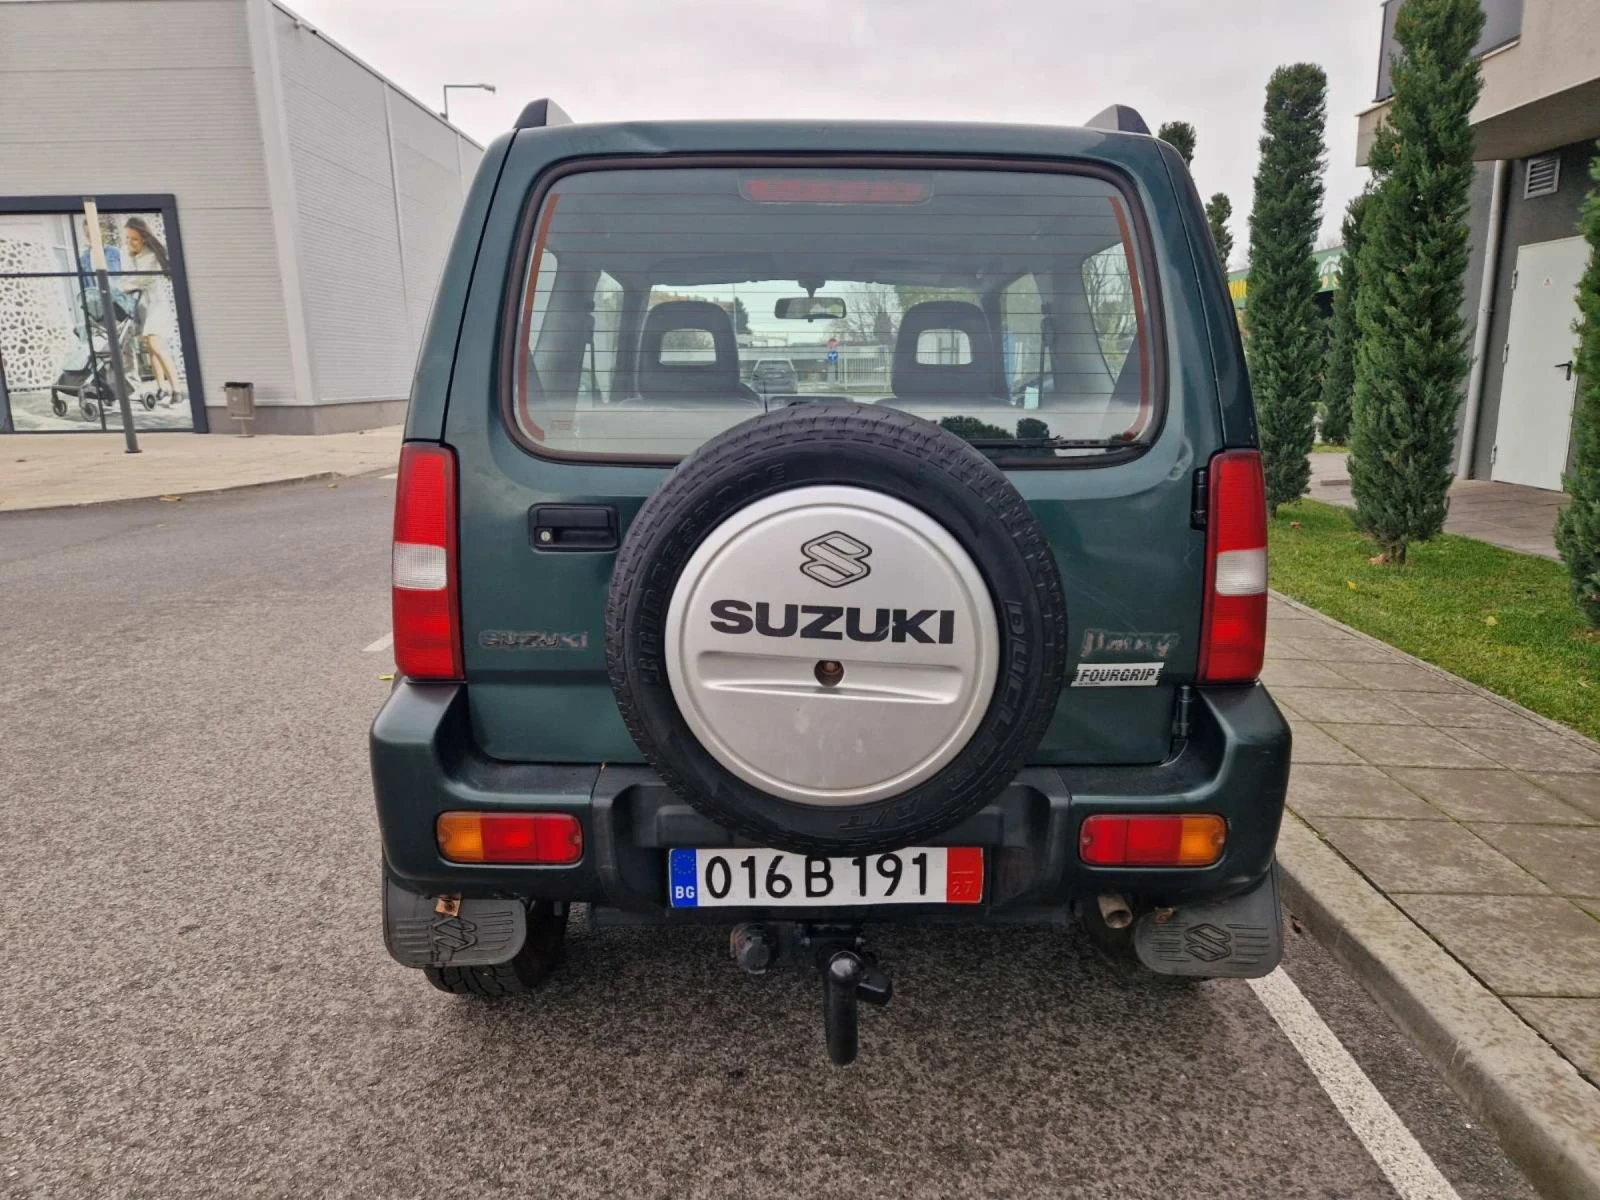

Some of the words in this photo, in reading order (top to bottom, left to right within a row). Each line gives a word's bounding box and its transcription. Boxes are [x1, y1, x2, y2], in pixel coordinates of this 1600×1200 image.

[710, 599, 955, 644] SUZUKI
[479, 630, 589, 650] SUZUKI
[1079, 668, 1156, 682] FOURGRIP
[705, 855, 793, 898] 016
[804, 856, 834, 897] B
[851, 853, 927, 896] 191
[675, 886, 695, 898] BG
